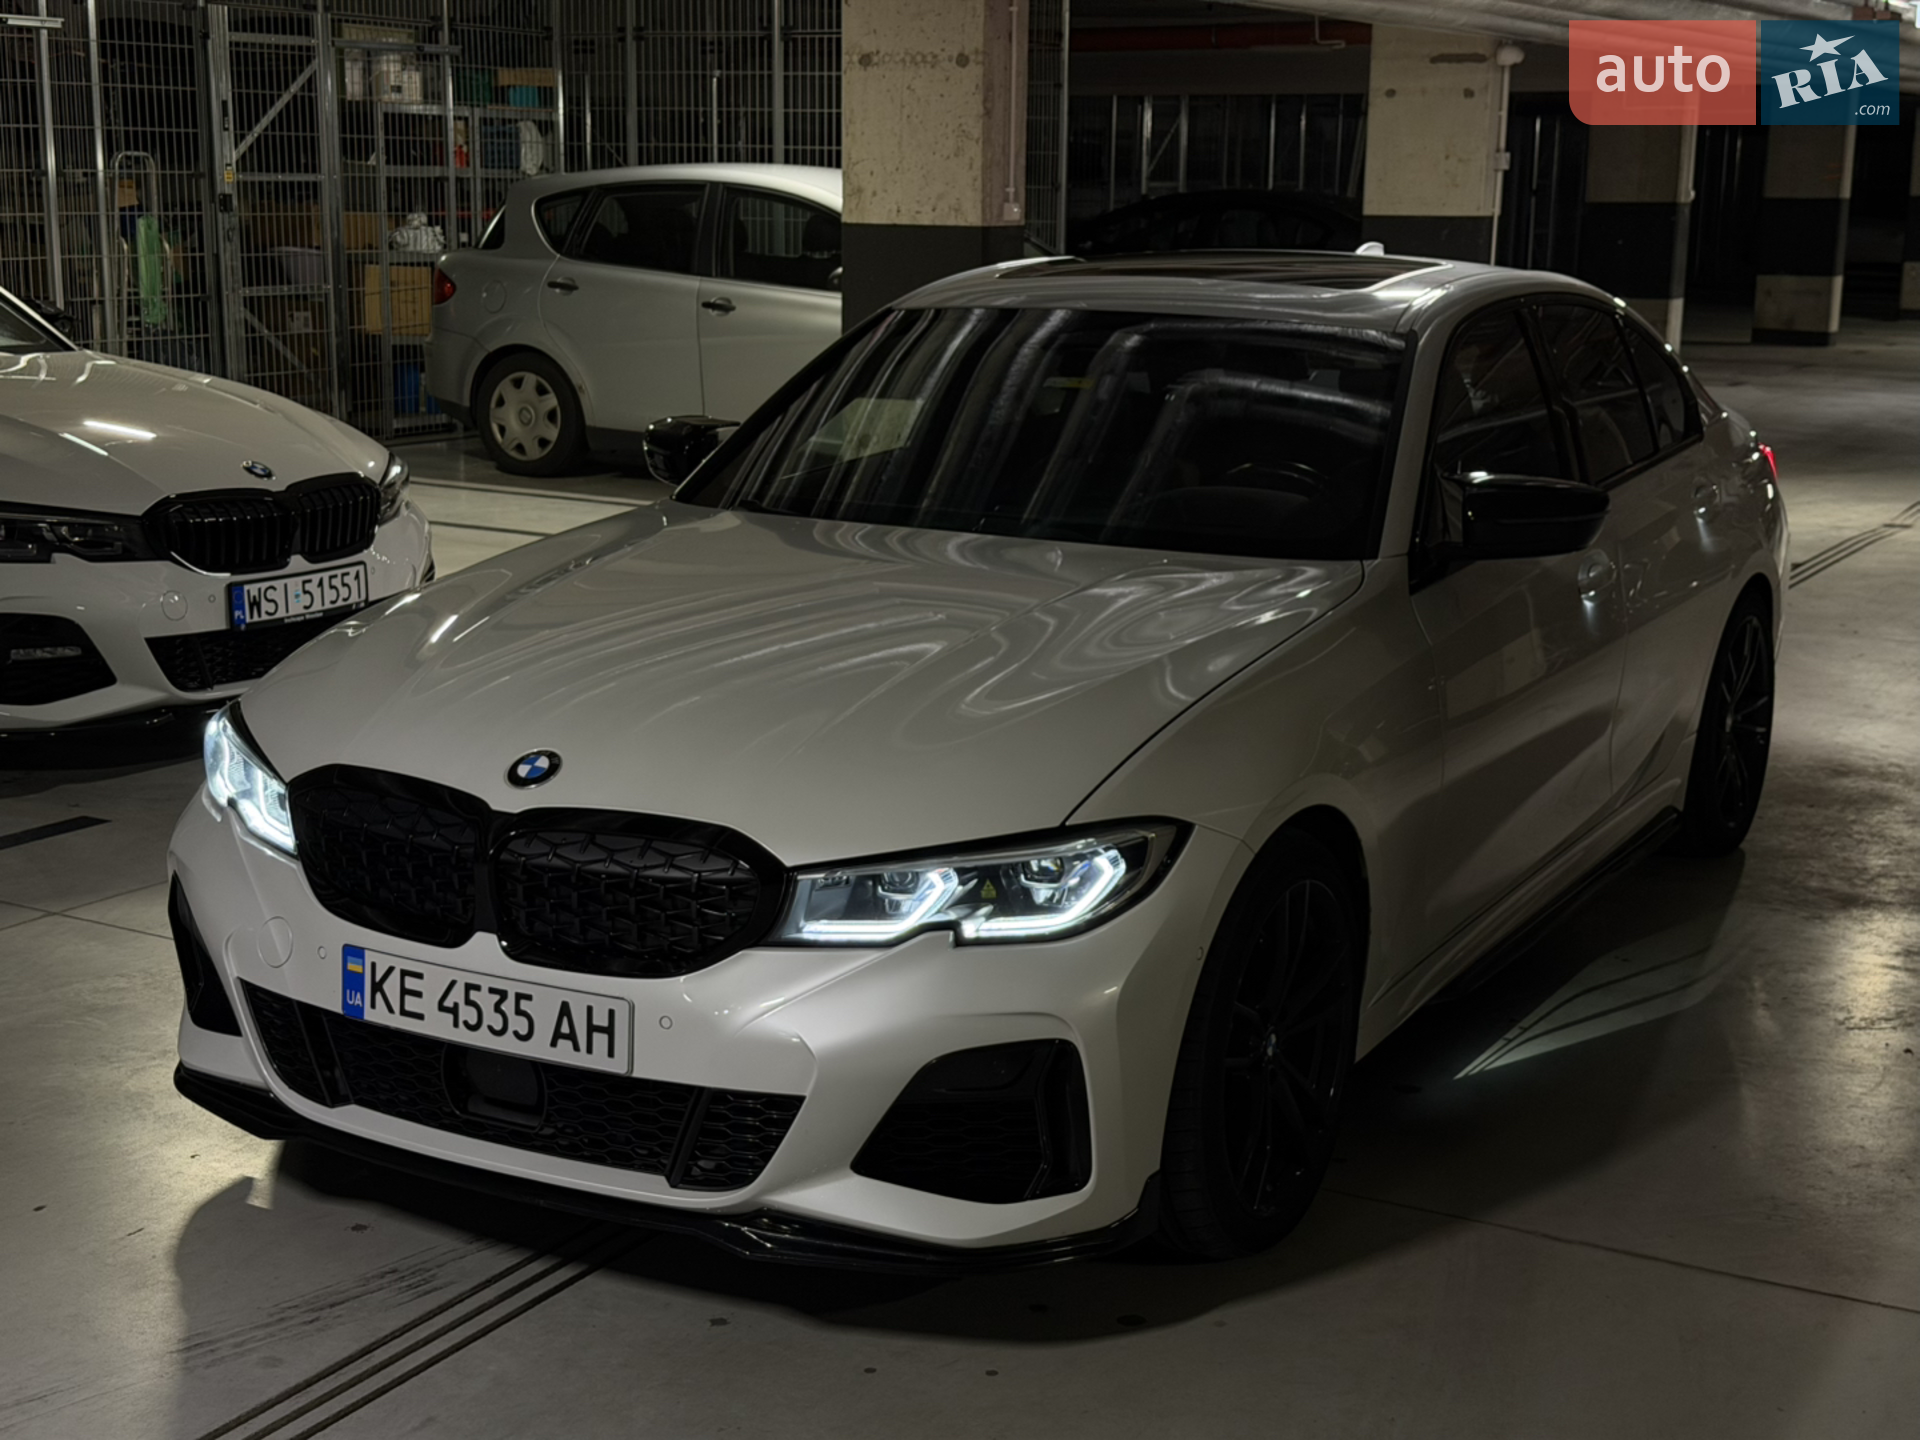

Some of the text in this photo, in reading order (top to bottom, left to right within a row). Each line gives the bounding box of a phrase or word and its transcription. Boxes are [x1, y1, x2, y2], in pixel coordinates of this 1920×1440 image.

[246, 569, 362, 620] WSI 51551
[234, 610, 245, 621] PL
[346, 989, 363, 1008] UA
[370, 961, 616, 1059] KE 4535 AH
